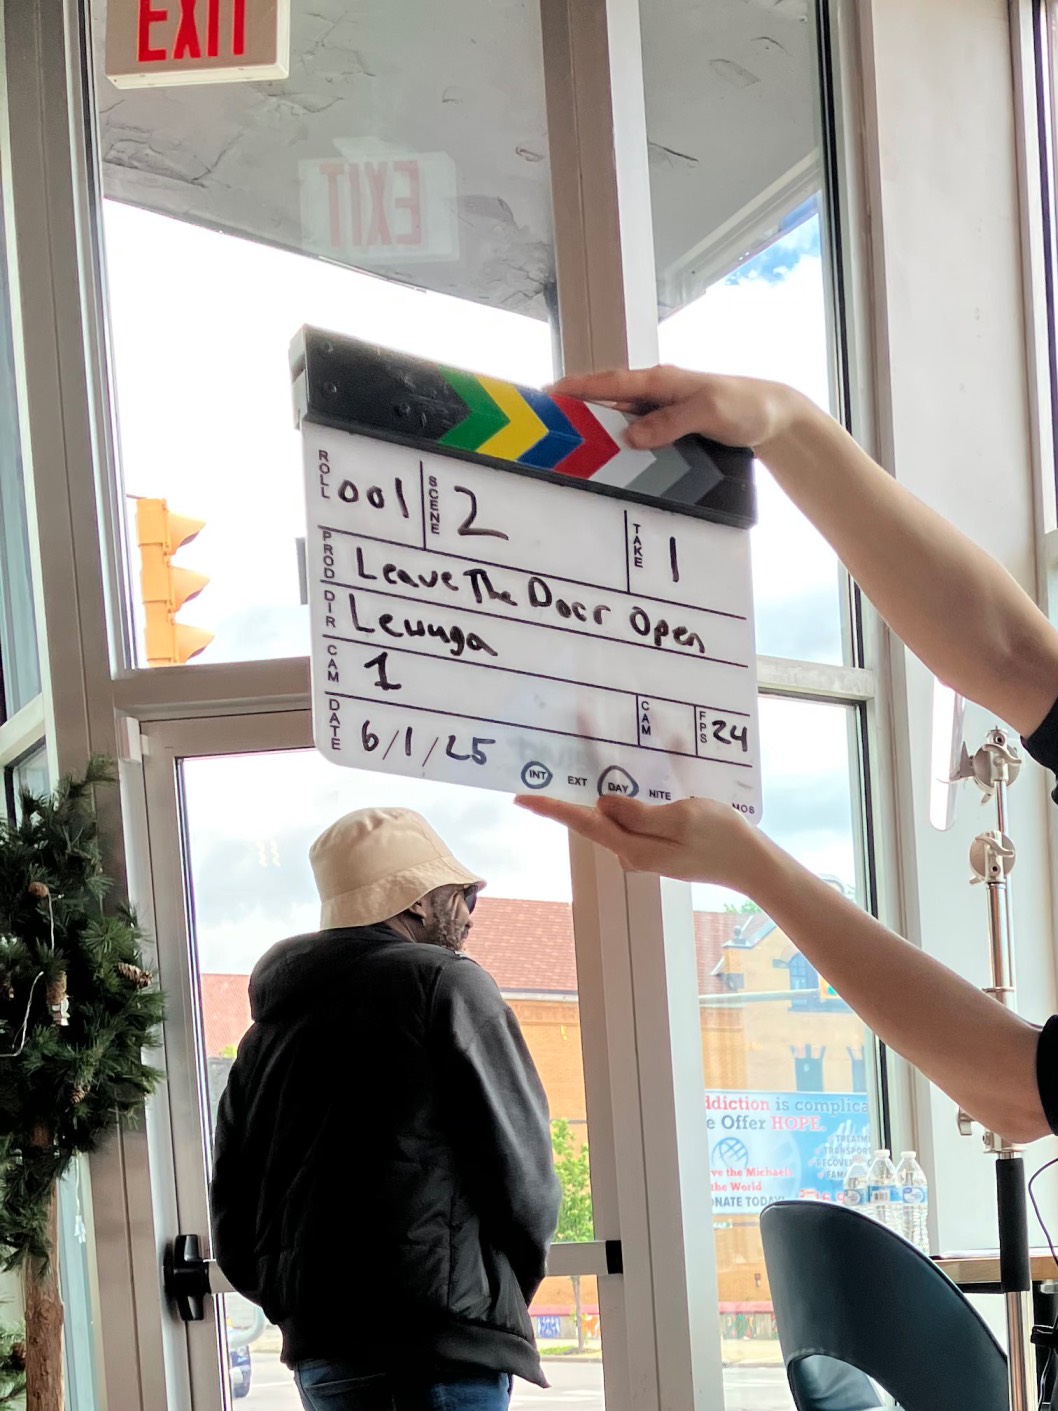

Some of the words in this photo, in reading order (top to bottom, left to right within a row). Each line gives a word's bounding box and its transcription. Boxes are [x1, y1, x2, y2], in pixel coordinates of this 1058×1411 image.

[137, 0, 245, 62] EXIT
[318, 449, 331, 500] ROLL
[428, 475, 440, 535] SCENE
[453, 485, 509, 541] 2
[322, 530, 335, 579] PROD
[632, 523, 643, 569] TAKE
[324, 590, 336, 628] DIR
[356, 546, 459, 592] Leave
[463, 568, 518, 607] The
[629, 606, 706, 654] Open
[327, 644, 340, 683] CAM
[363, 651, 402, 691] 1
[329, 698, 342, 751] DATE
[641, 701, 652, 736] CAM
[699, 711, 708, 744] FPS
[711, 720, 748, 752] 24
[529, 769, 547, 781] INT
[567, 775, 588, 788] EXT
[607, 781, 629, 794] DAY
[648, 788, 672, 801] NITE
[721, 1114, 766, 1130] Offer
[776, 1096, 790, 1111] is
[726, 1168, 743, 1177] the
[730, 1181, 762, 1192] World
